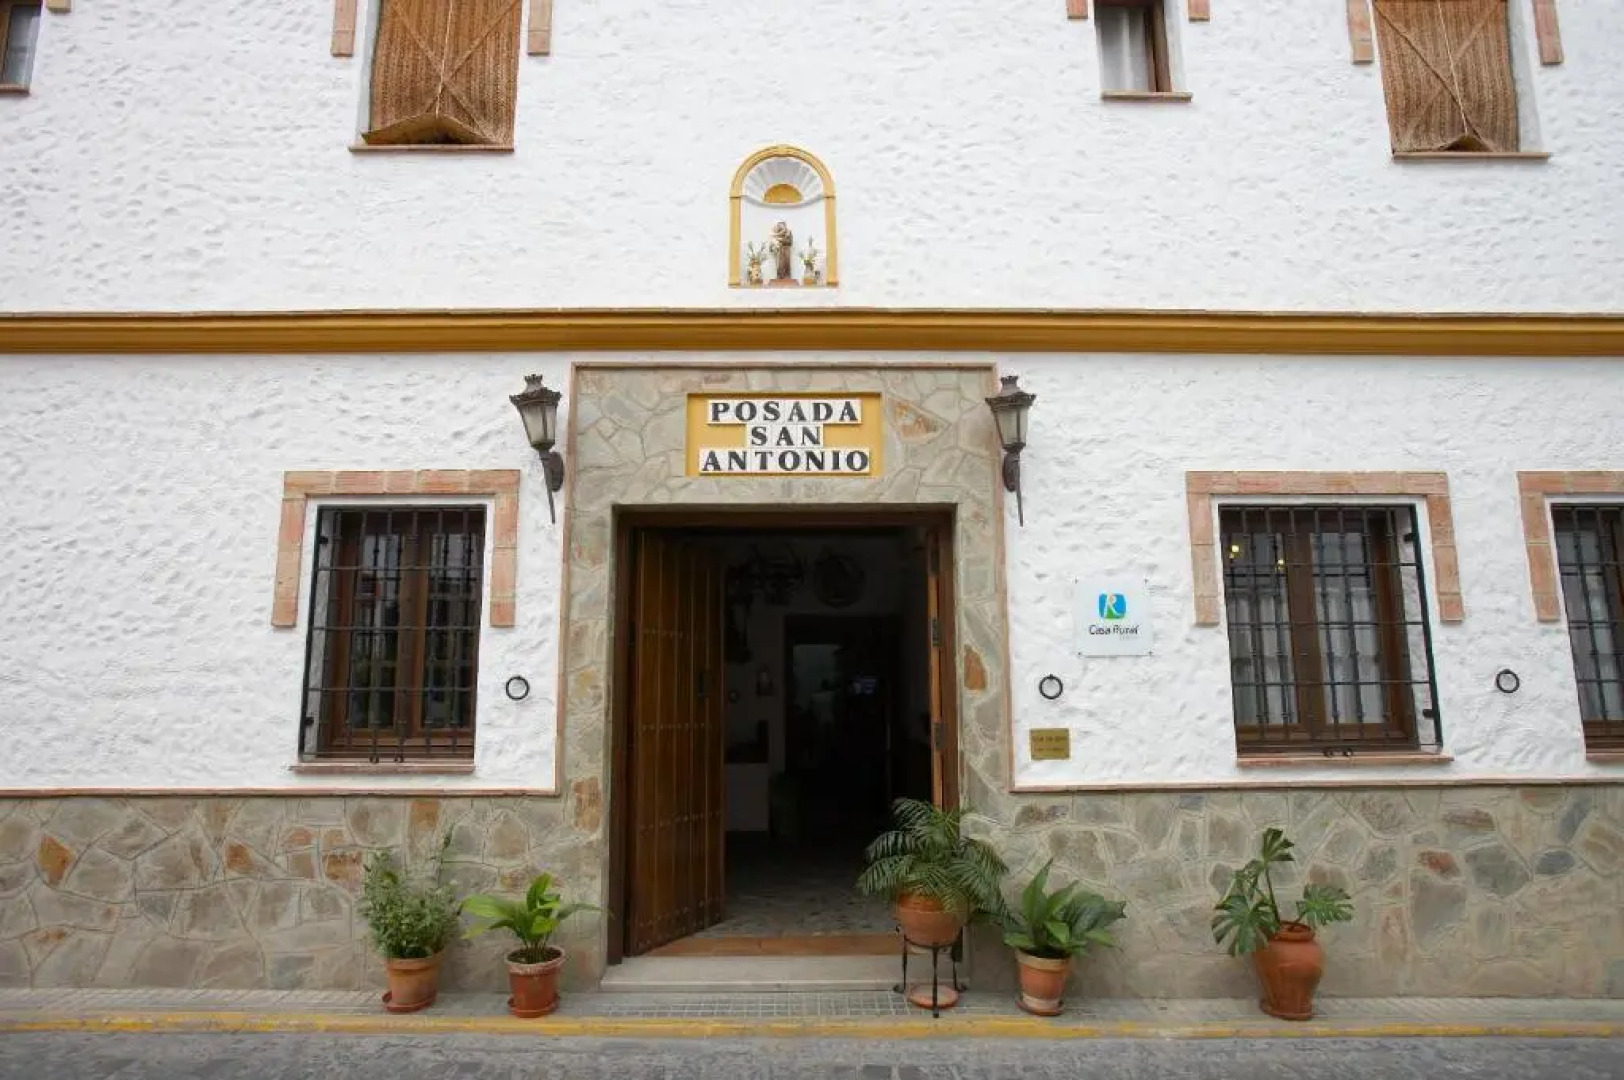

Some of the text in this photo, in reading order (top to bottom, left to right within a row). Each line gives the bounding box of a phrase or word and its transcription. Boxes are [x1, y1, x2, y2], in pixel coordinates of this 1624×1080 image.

[710, 400, 859, 423] POSADA
[750, 426, 821, 447] SAN
[701, 450, 869, 472] ANTONIO
[1089, 624, 1111, 635] Casa
